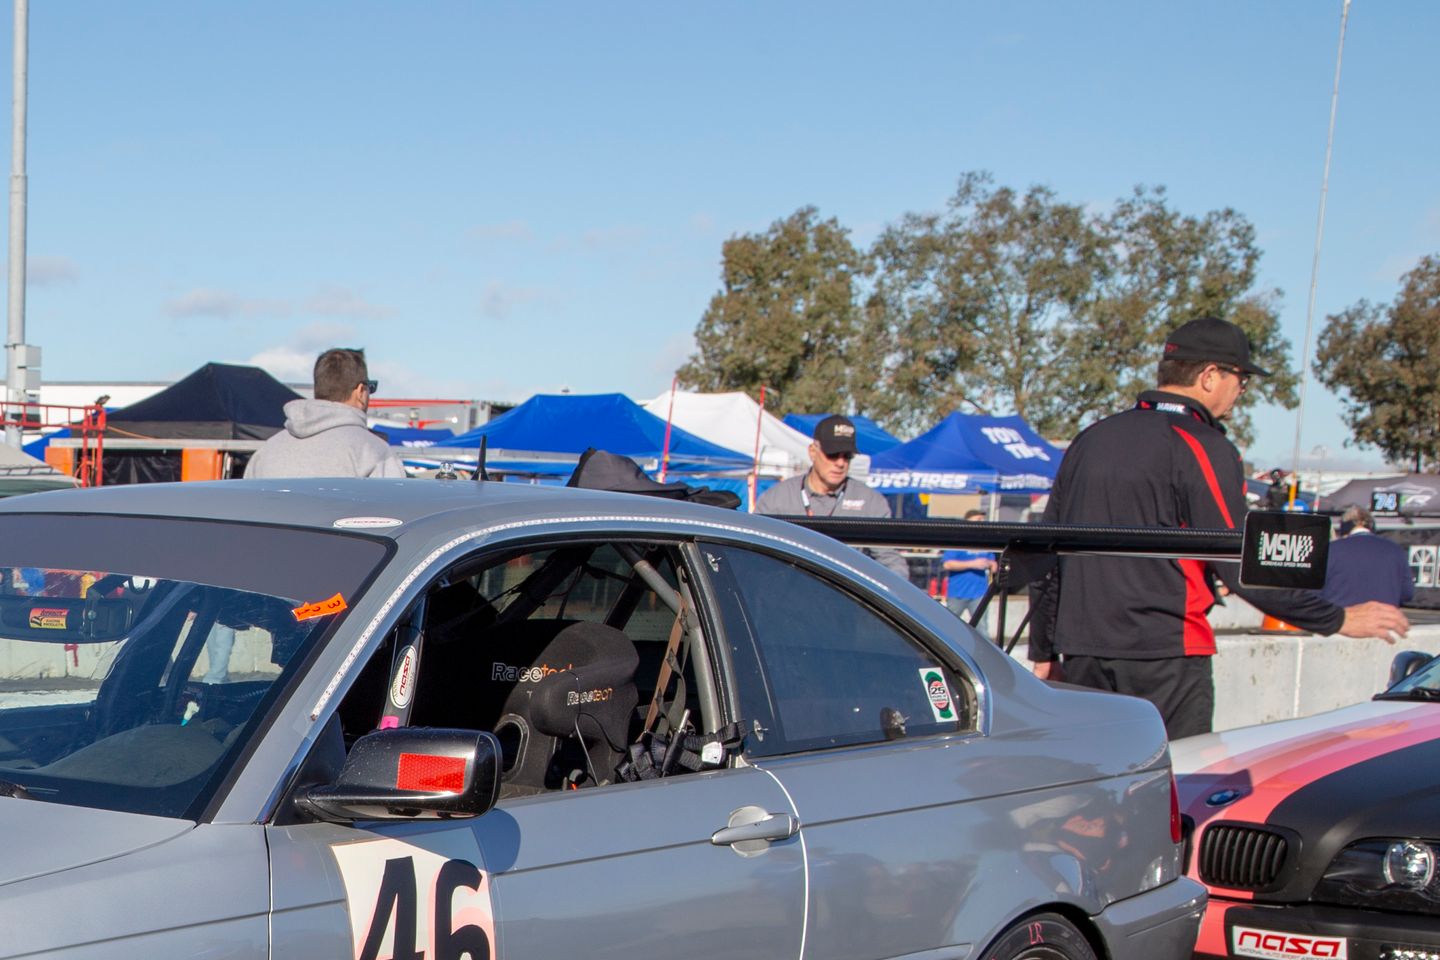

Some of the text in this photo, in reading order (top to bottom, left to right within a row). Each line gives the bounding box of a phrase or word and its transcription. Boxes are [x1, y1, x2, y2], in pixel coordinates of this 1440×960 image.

[1156, 401, 1186, 415] HAWK
[907, 472, 968, 489] TIRES
[1374, 493, 1398, 511] 74
[1262, 532, 1304, 562] MSW
[567, 688, 613, 706] Racetech
[1028, 922, 1044, 944] LR
